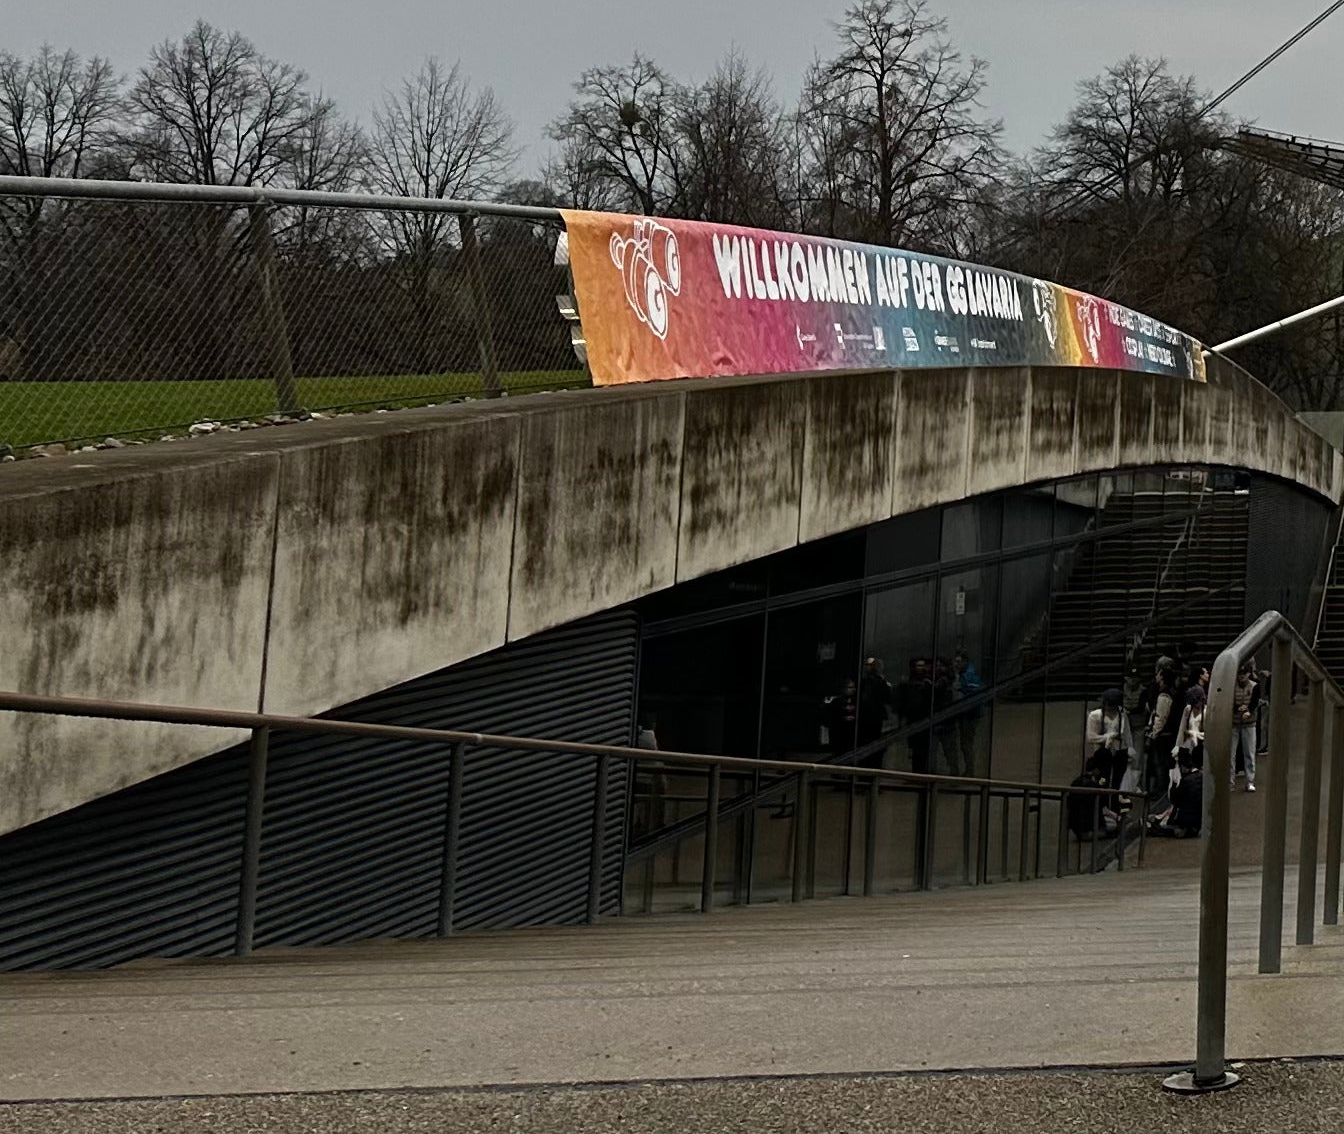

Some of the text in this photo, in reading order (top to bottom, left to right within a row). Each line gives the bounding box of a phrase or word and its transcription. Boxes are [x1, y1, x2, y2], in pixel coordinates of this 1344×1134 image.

[713, 233, 871, 305] WILLKOMMEN
[876, 254, 910, 308] AUF
[912, 260, 945, 312] DER
